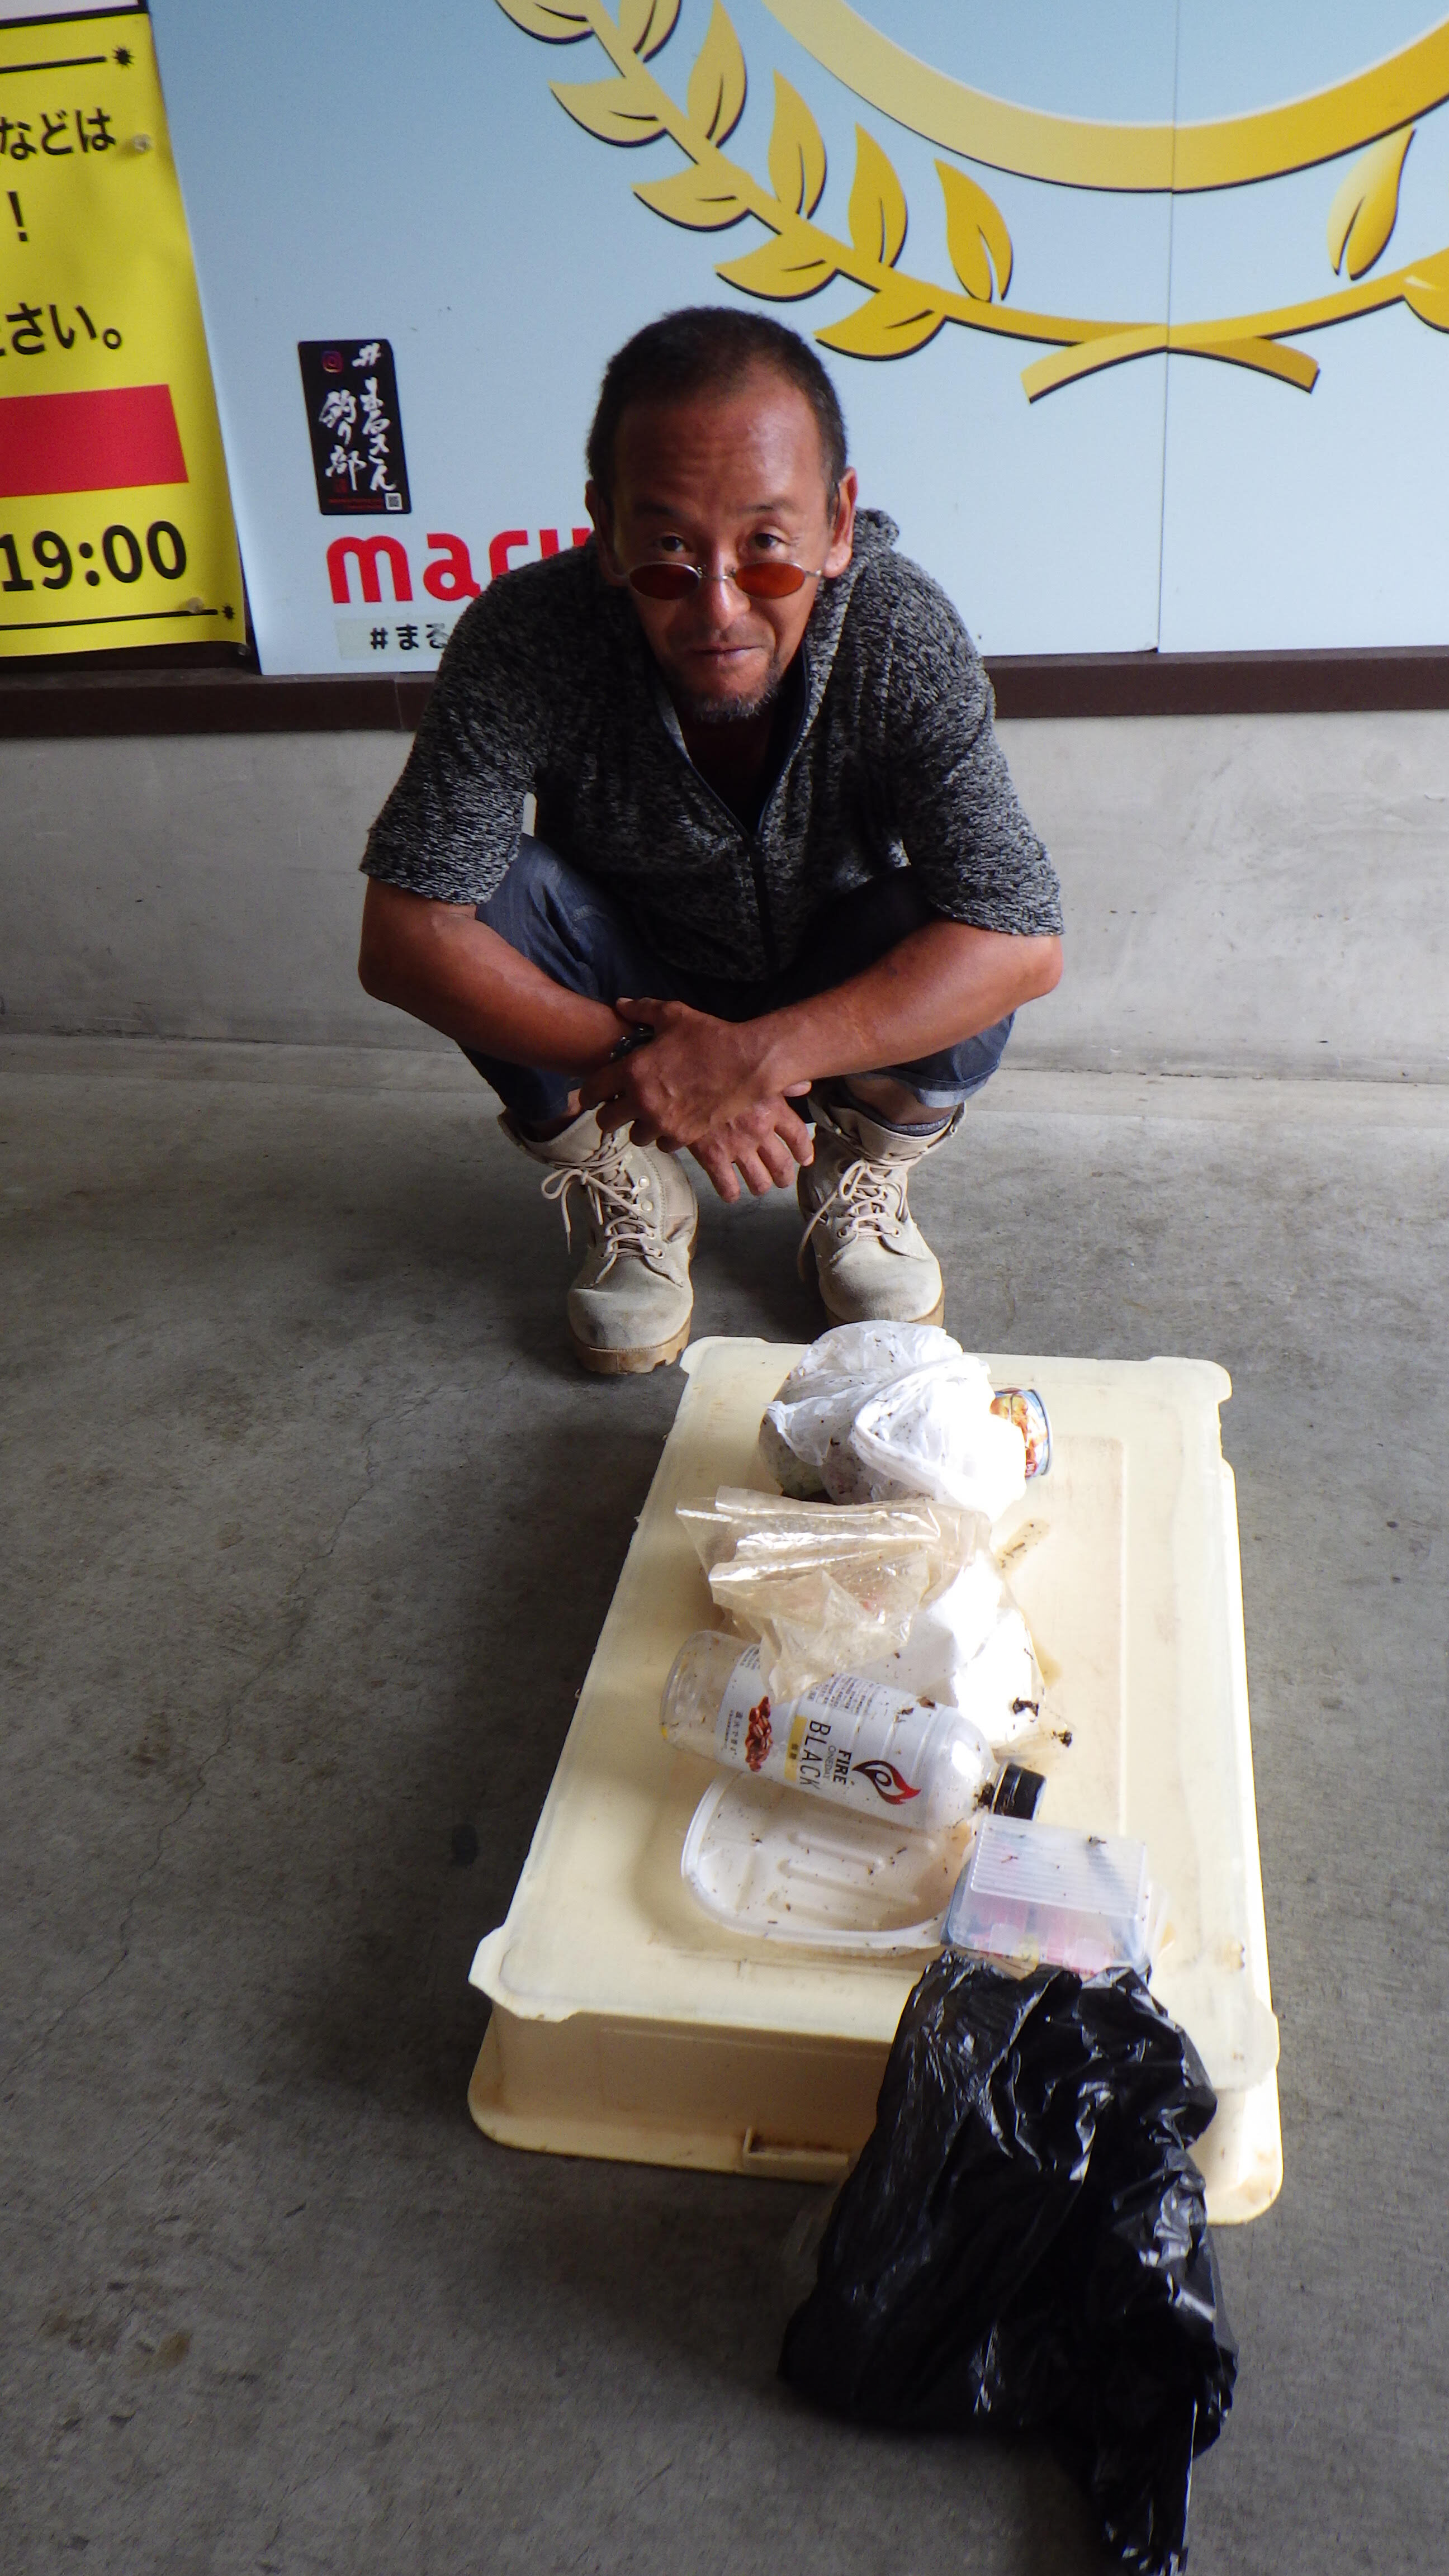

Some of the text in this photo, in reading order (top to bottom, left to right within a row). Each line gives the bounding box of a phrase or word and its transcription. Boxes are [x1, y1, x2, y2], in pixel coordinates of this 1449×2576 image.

[0, 107, 116, 160] などは
[0, 302, 122, 356] さい。
[0, 520, 187, 591] 19:00
[799, 1720, 832, 1789] BLACK
[833, 1748, 853, 1785] FIRE
